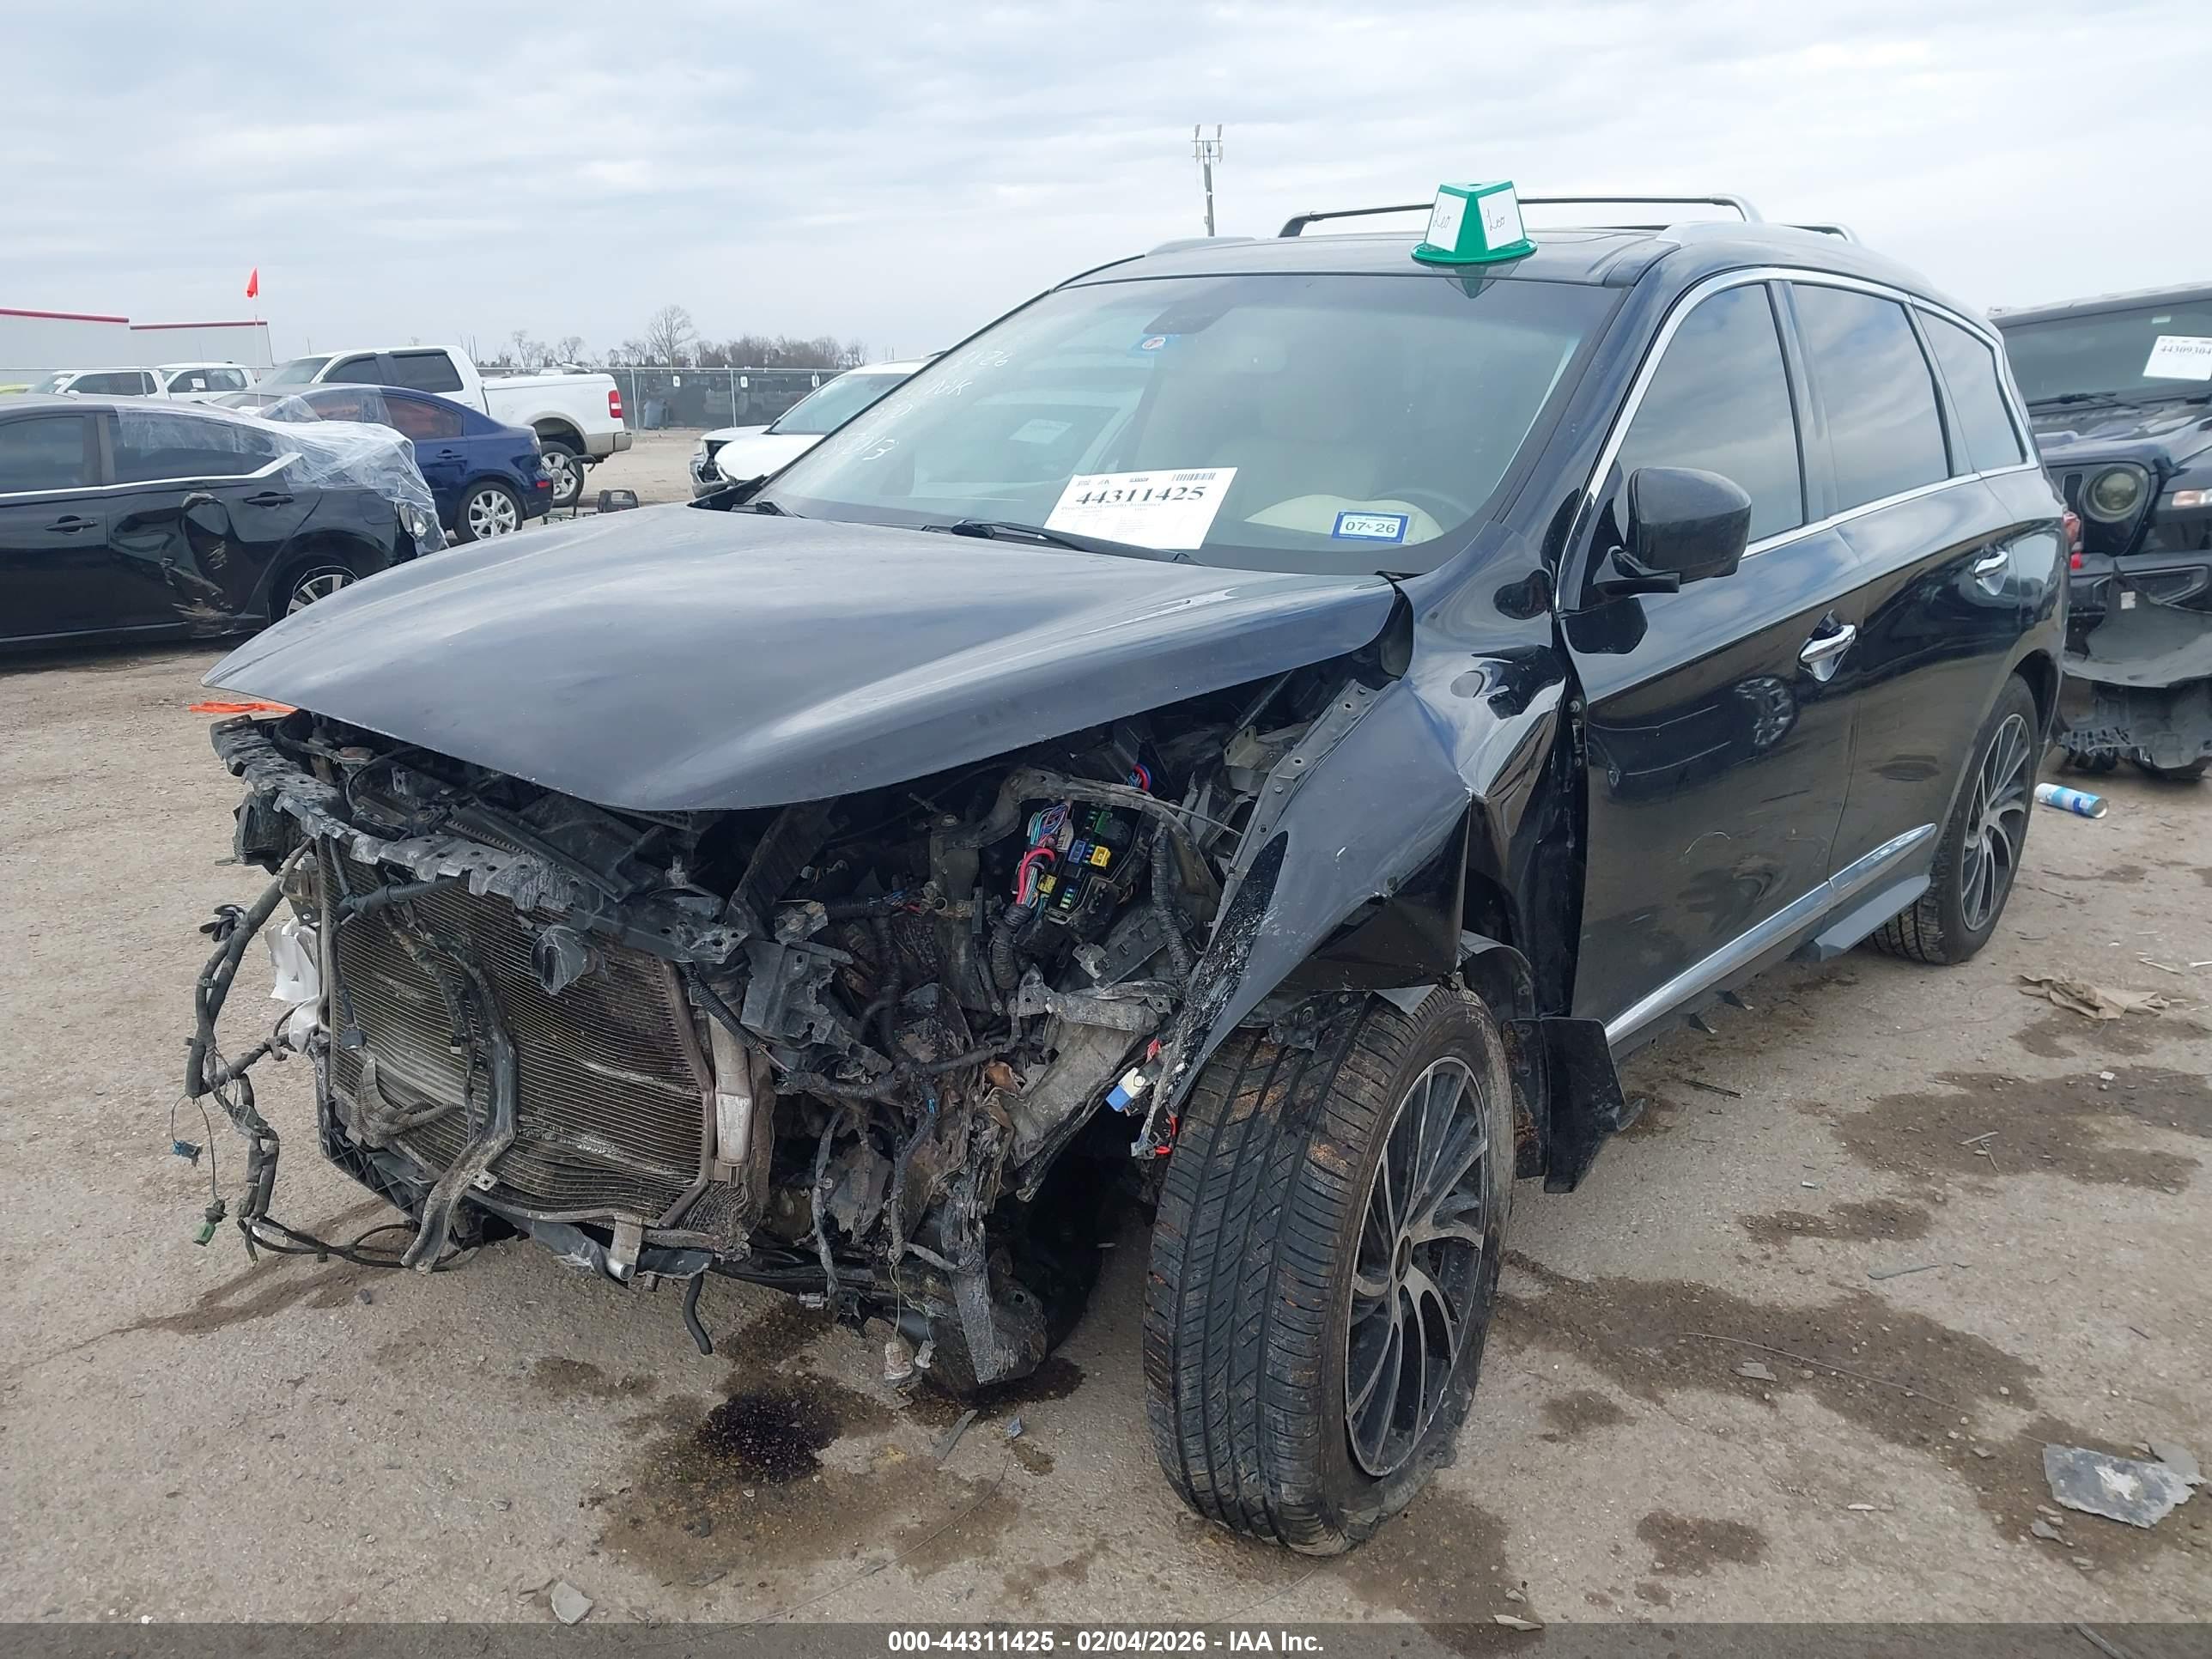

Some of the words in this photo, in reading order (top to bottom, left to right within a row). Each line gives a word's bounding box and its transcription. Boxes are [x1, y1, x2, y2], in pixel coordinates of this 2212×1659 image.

[1076, 486, 1206, 505] 44311425
[1345, 521, 1366, 532] 07
[1374, 523, 1396, 533] 26
